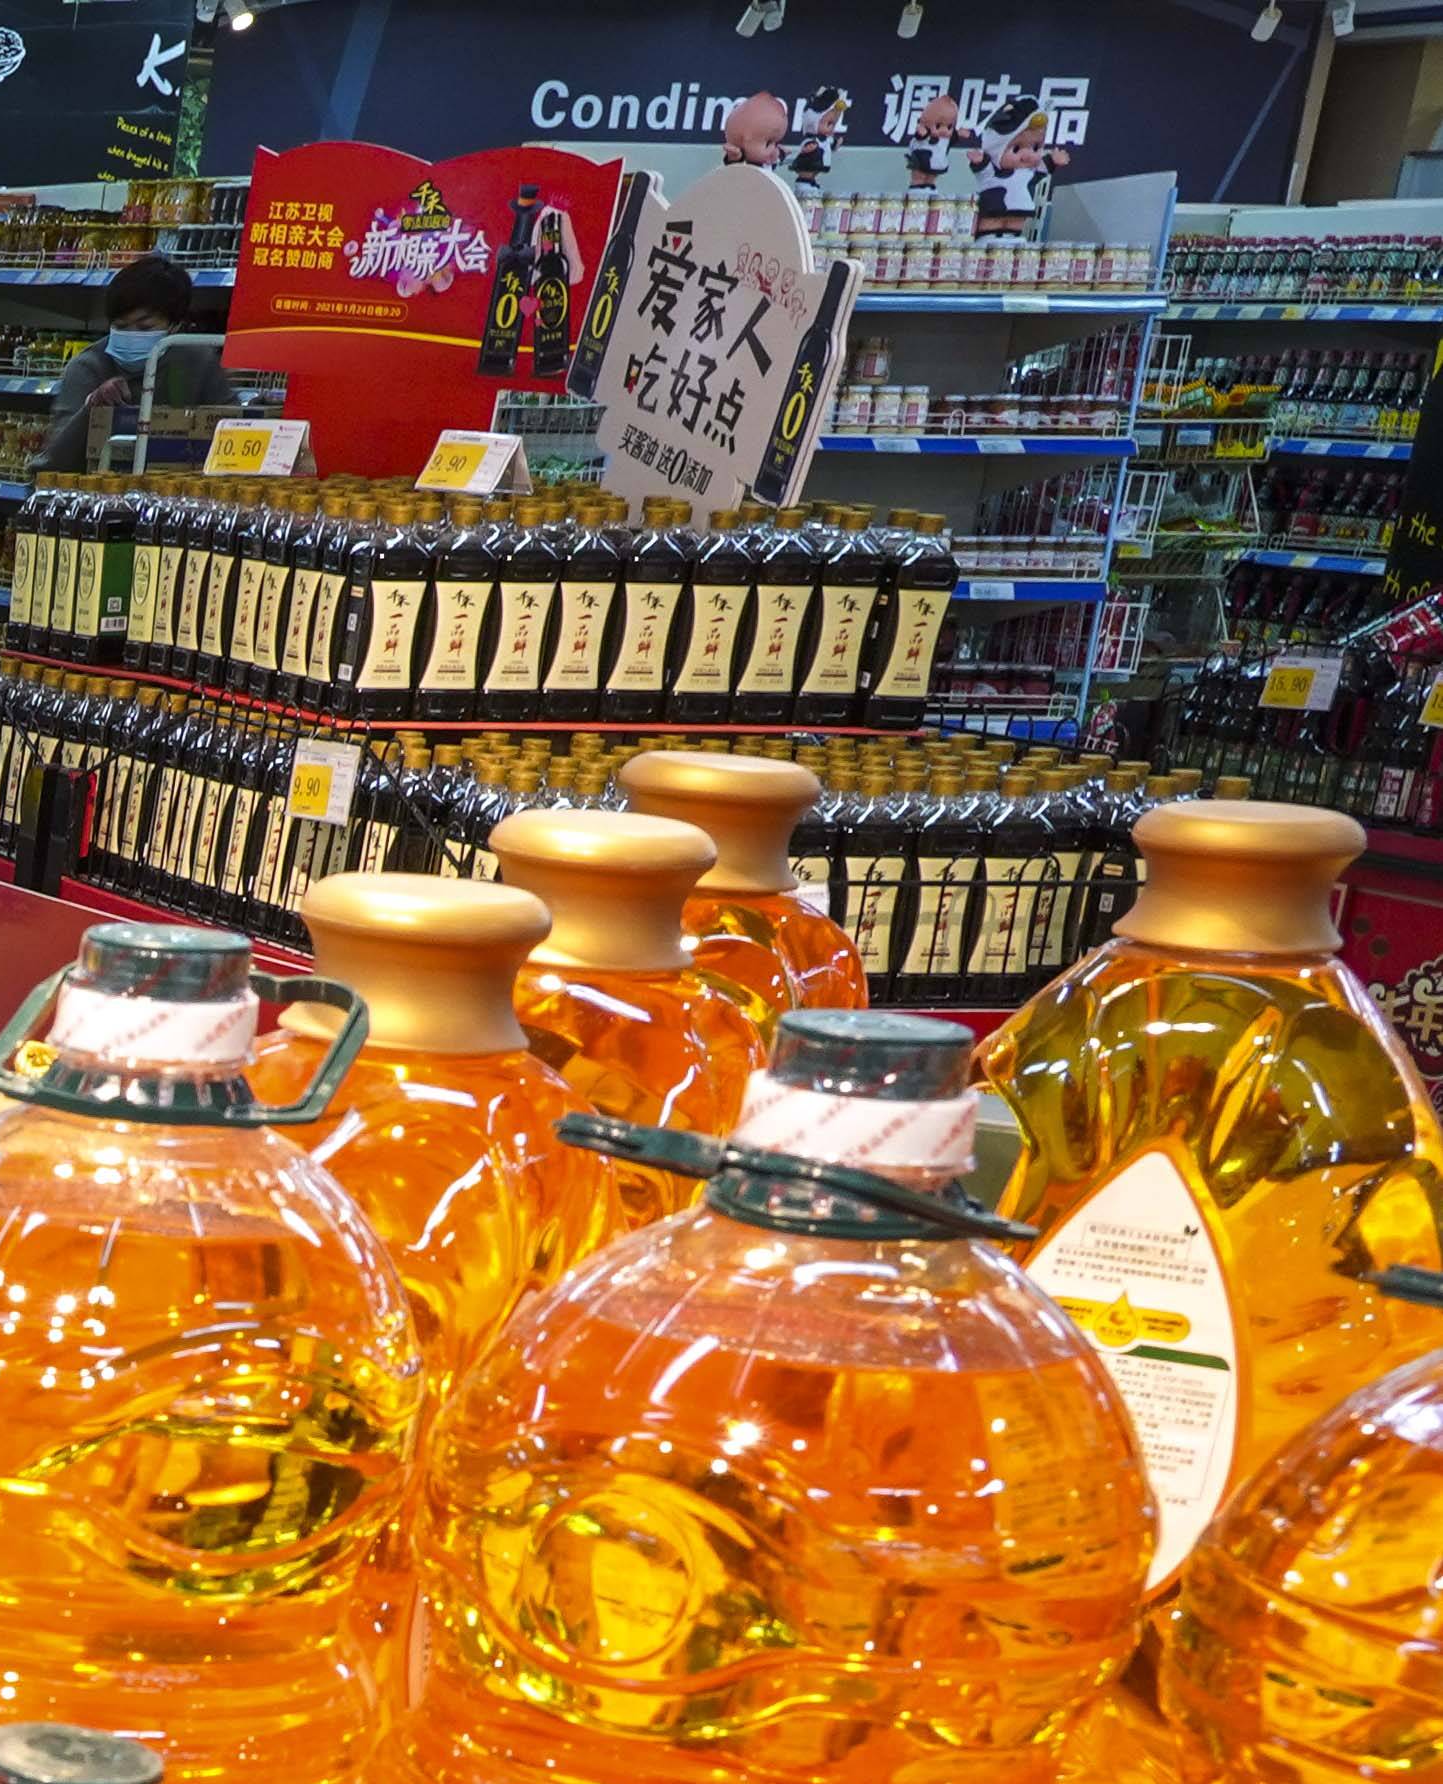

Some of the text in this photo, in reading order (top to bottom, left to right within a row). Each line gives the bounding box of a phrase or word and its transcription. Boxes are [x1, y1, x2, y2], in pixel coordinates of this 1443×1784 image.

[268, 201, 334, 222] 江苏卫视
[249, 222, 345, 248] 新相亲大会
[349, 219, 491, 280] 新相亲大会
[252, 247, 334, 270] 冠名赞助商
[637, 220, 773, 377] 爱家人
[627, 348, 746, 456] 吃好点
